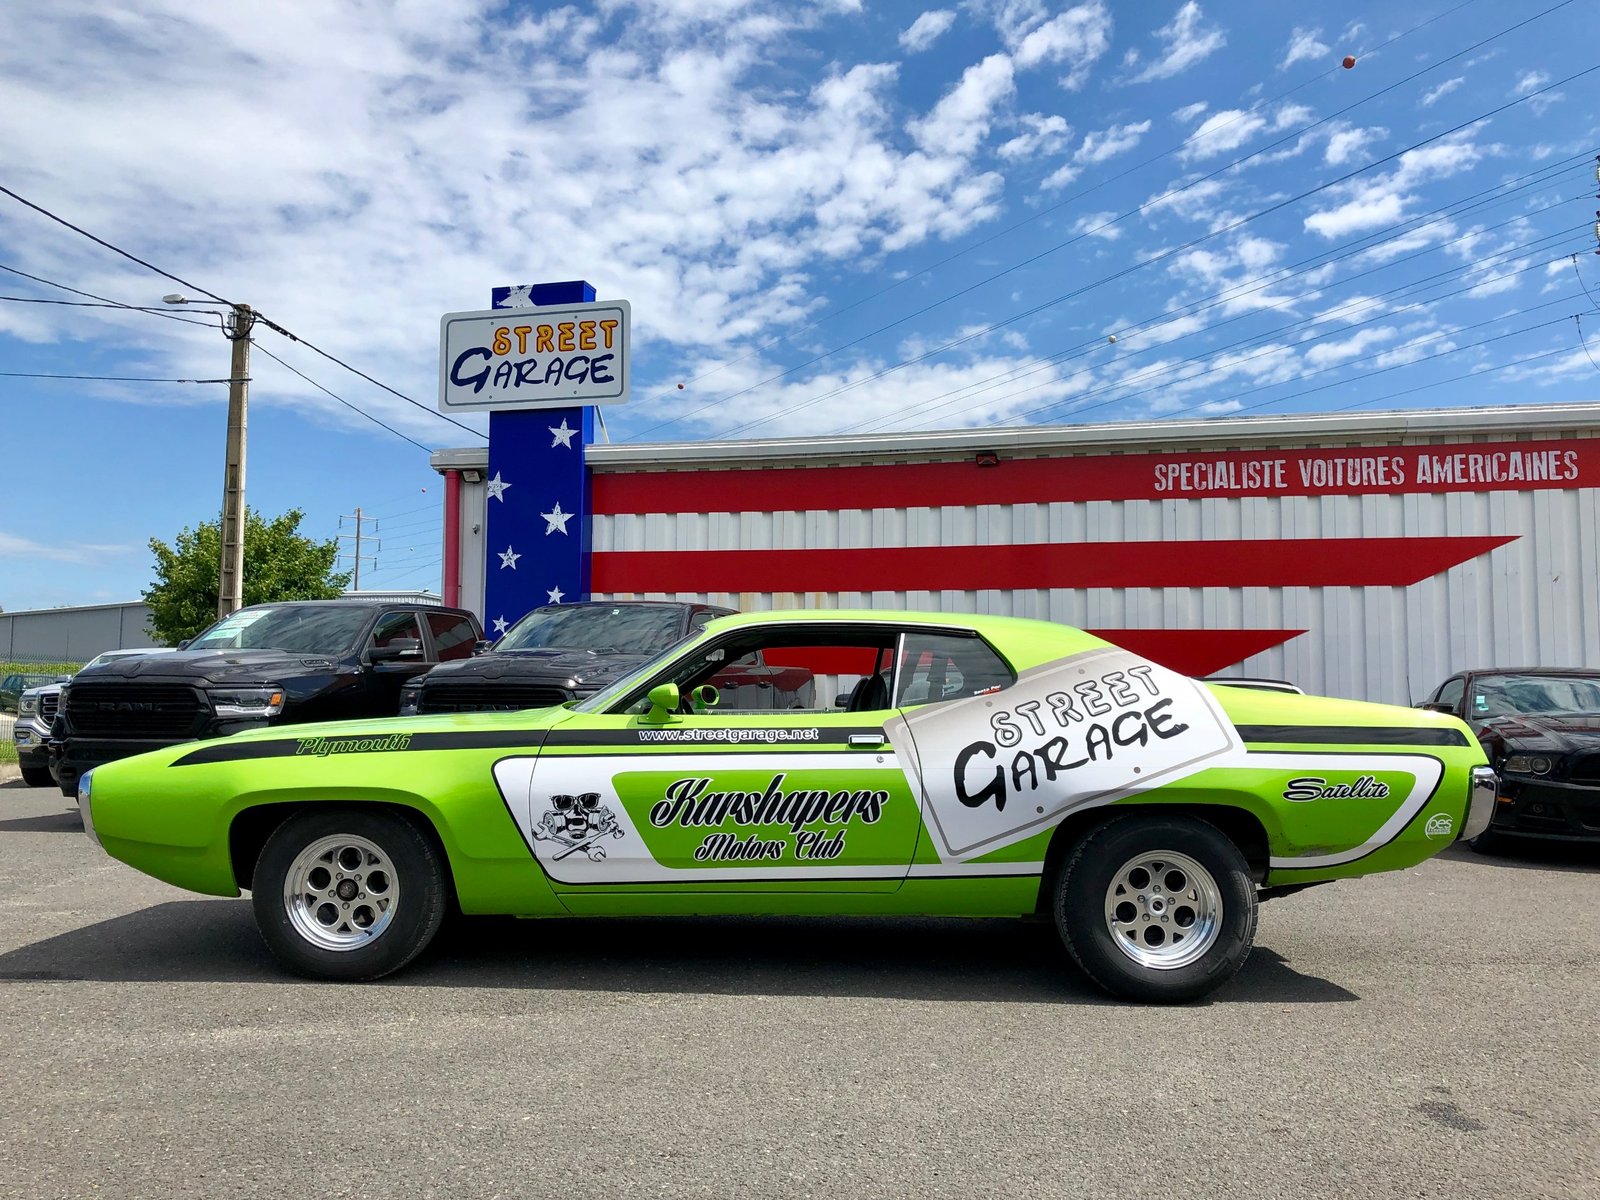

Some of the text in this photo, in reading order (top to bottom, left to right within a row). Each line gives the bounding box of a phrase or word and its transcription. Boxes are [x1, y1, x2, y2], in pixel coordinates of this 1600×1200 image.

[493, 320, 619, 355] STREET
[450, 347, 616, 394] GARAGE
[1153, 450, 1579, 491] SPECIALISTE VOITURES AMERICAINES
[99, 702, 153, 711] RAM
[990, 665, 1160, 747] STREET
[295, 733, 413, 757] Plymouth
[638, 728, 819, 743] www.streetgarage.net
[953, 698, 1190, 812] GARAGE
[649, 773, 889, 832] Karshapers
[1282, 776, 1390, 803] Satellite
[694, 829, 847, 861] Motors Club
